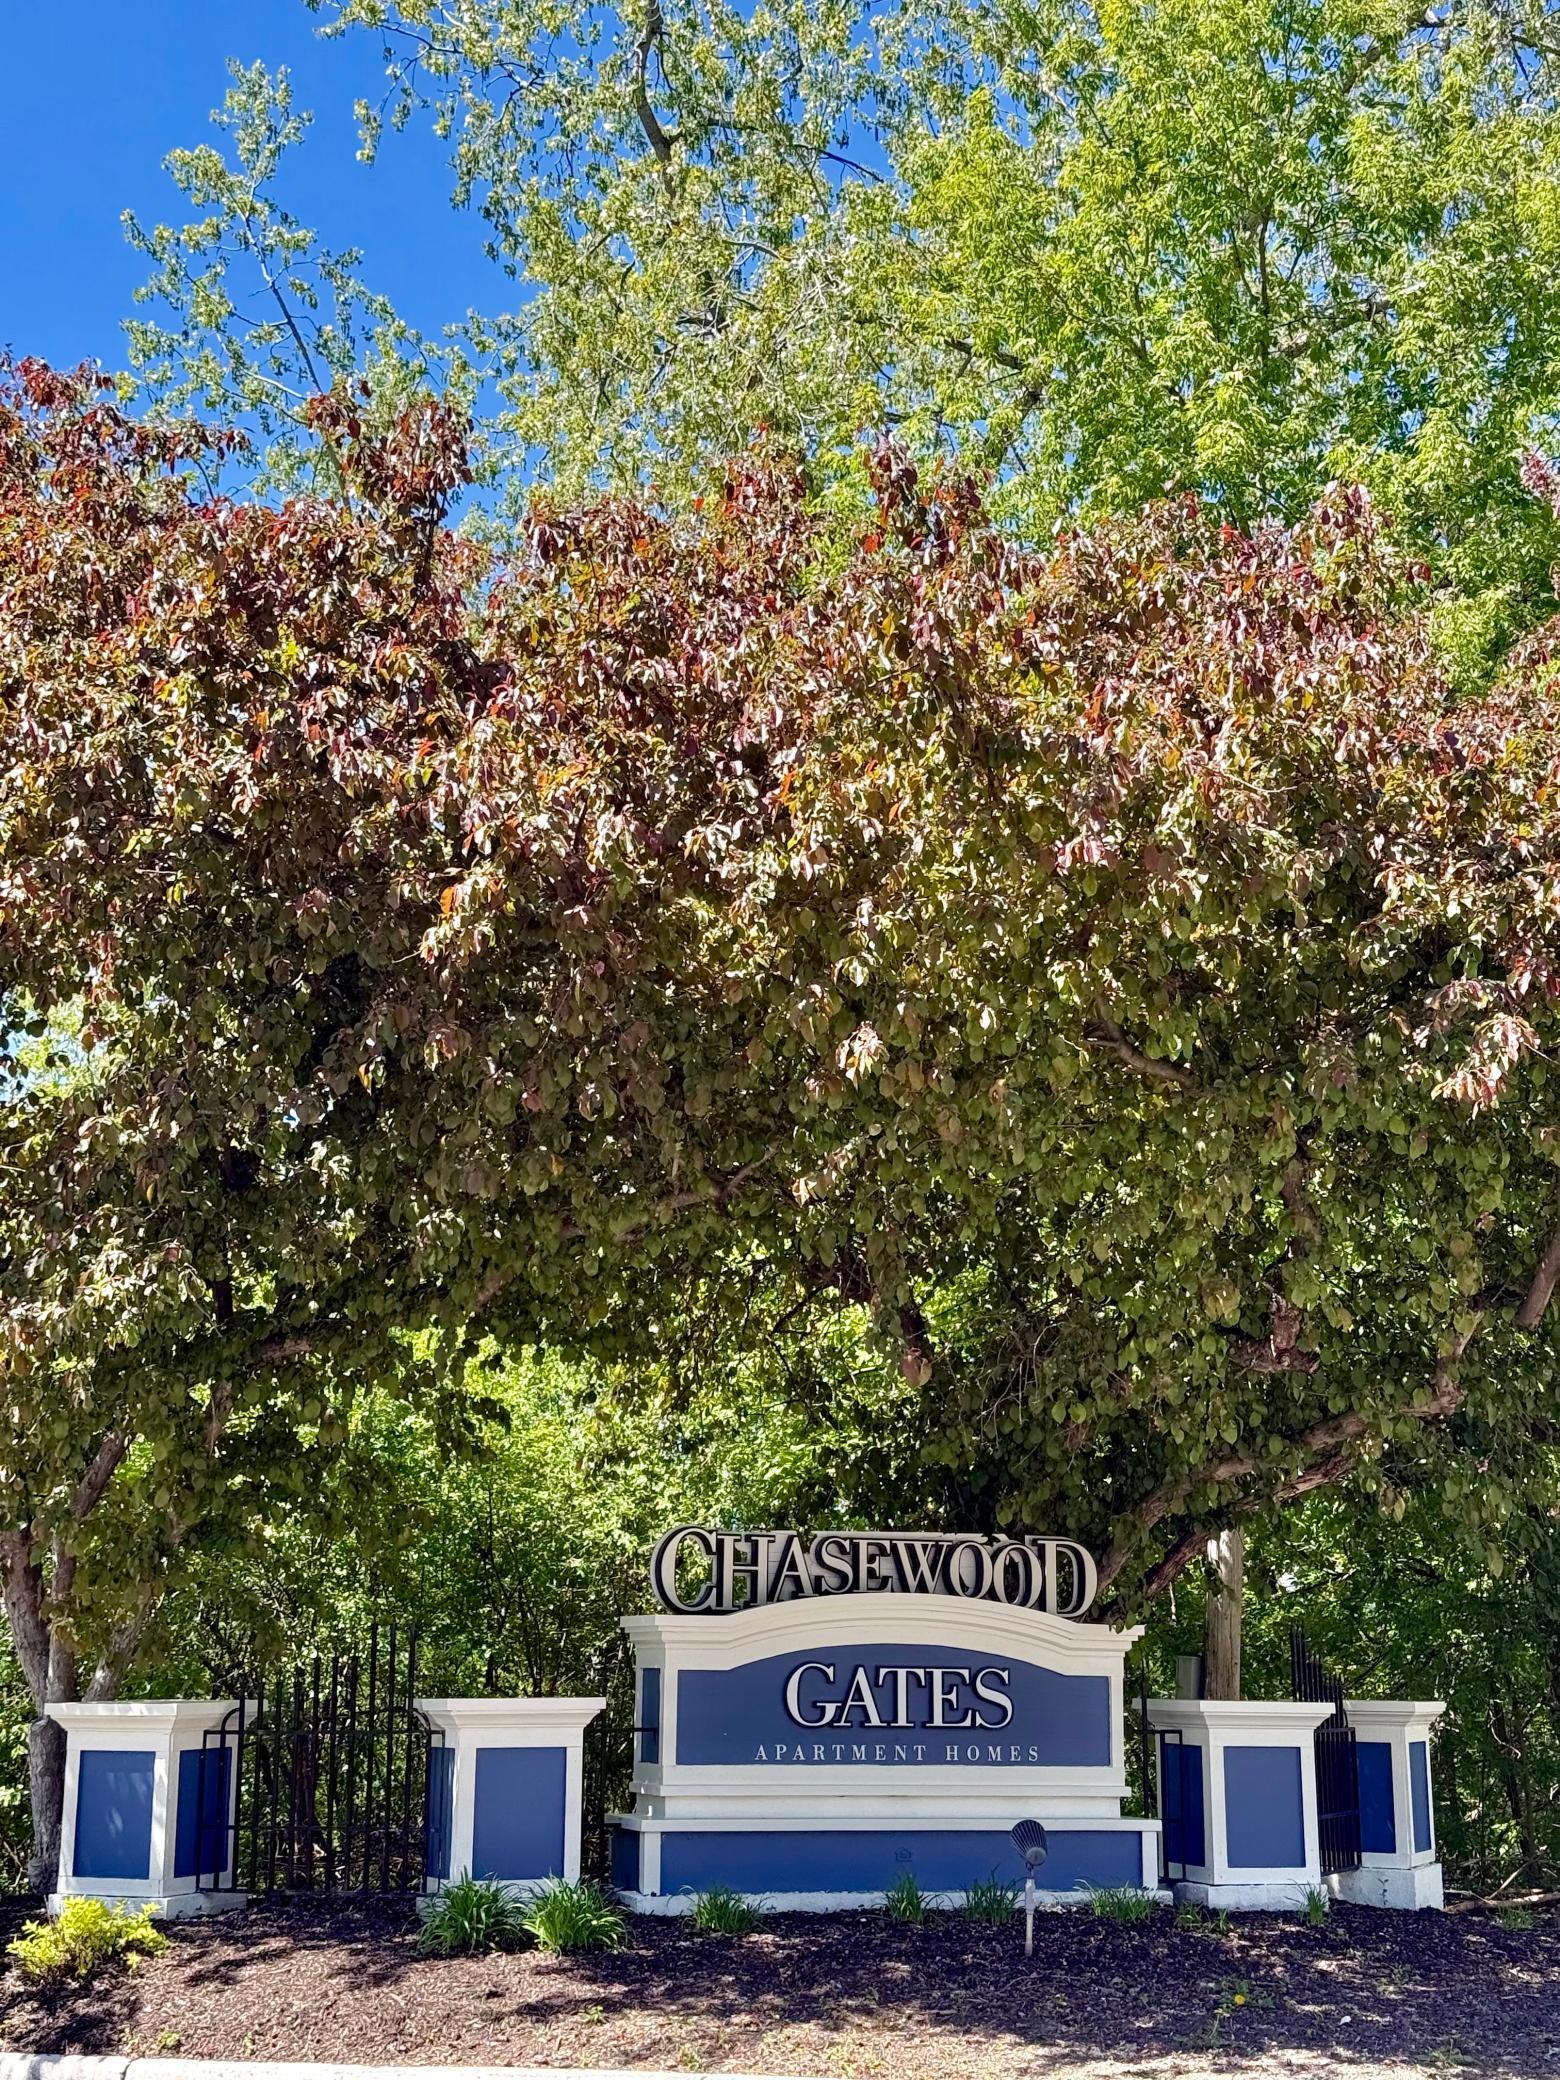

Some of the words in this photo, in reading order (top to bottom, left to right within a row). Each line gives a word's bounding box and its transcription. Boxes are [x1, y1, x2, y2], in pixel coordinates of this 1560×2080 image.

[652, 1526, 1099, 1617] CHASEWOOD
[785, 1663, 1014, 1729] GATES
[754, 1743, 927, 1762] APARTMENT
[945, 1744, 1041, 1763] HOMES
